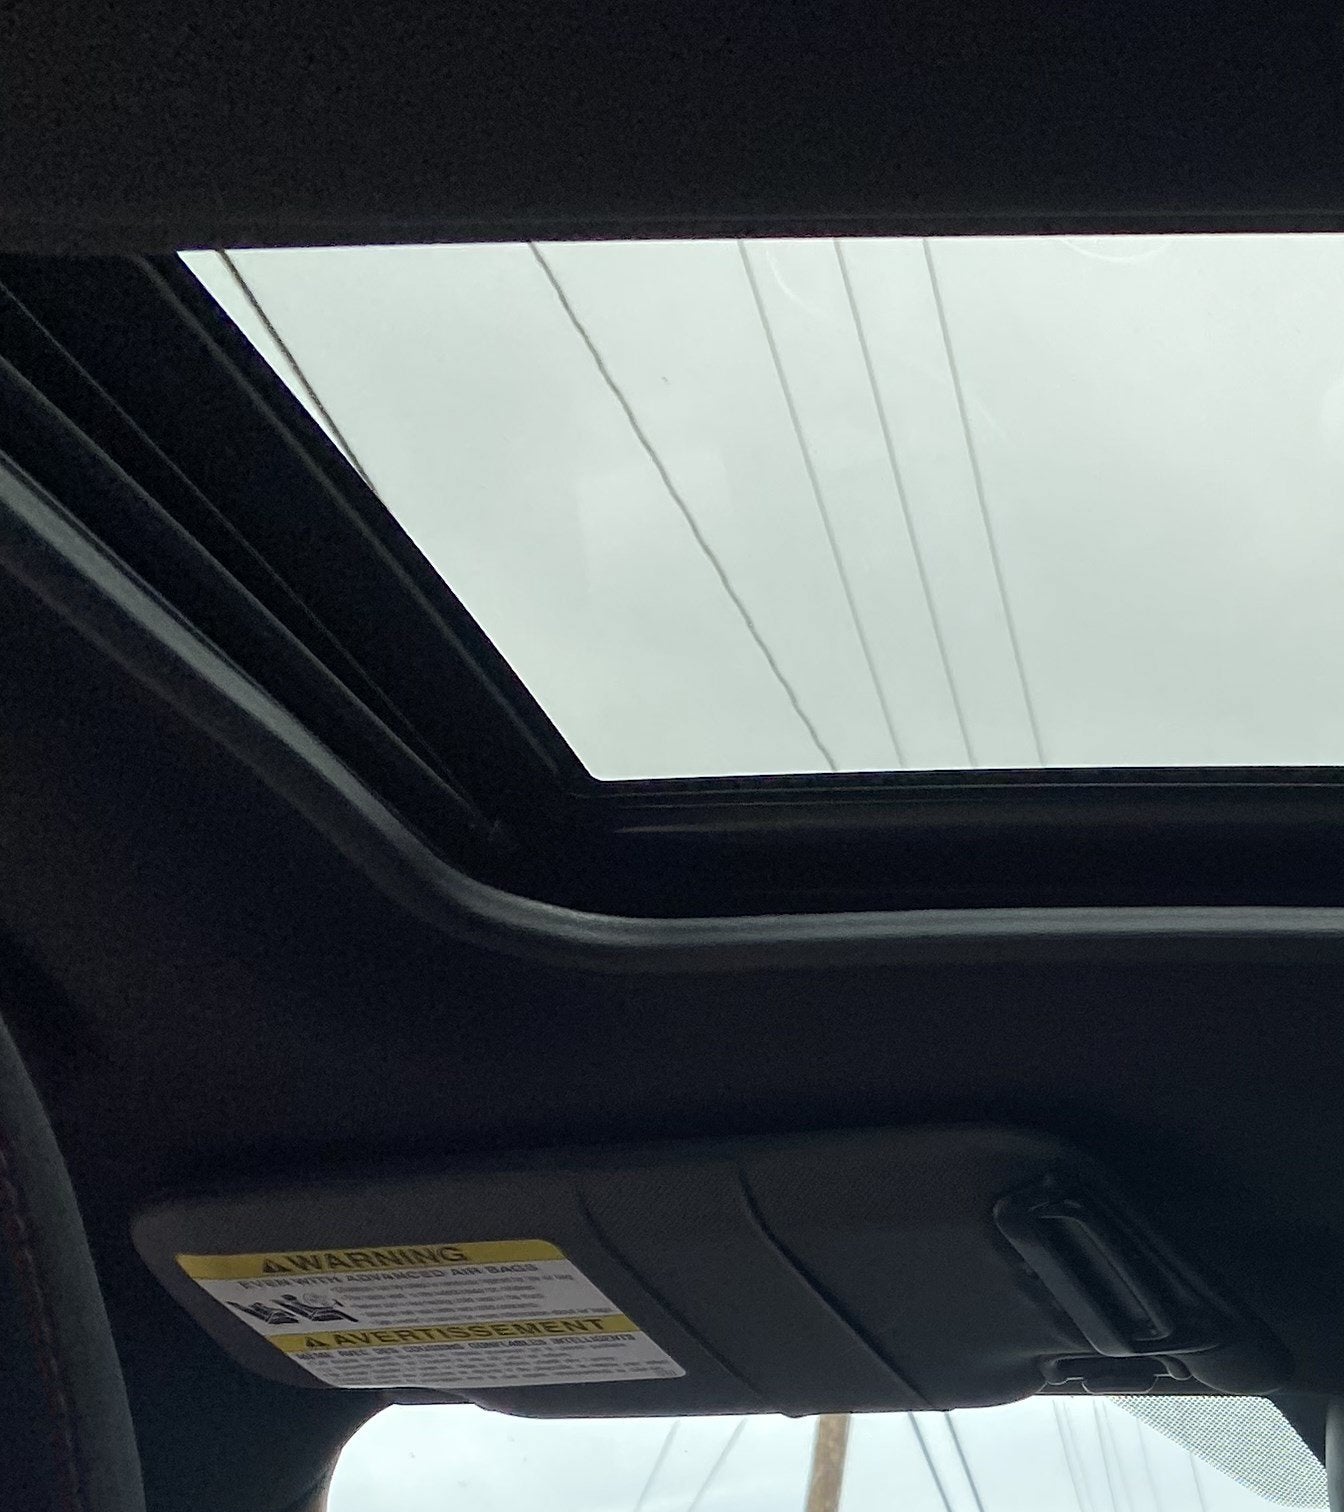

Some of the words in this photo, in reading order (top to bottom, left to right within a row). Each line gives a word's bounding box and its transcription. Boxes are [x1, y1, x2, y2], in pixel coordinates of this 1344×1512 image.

[286, 1246, 468, 1271] WARNING
[346, 1269, 443, 1282] ADVANCED
[451, 1266, 482, 1277] AIR
[484, 1263, 539, 1274] BAGS
[334, 1318, 605, 1346] AVERTISSEMENT
